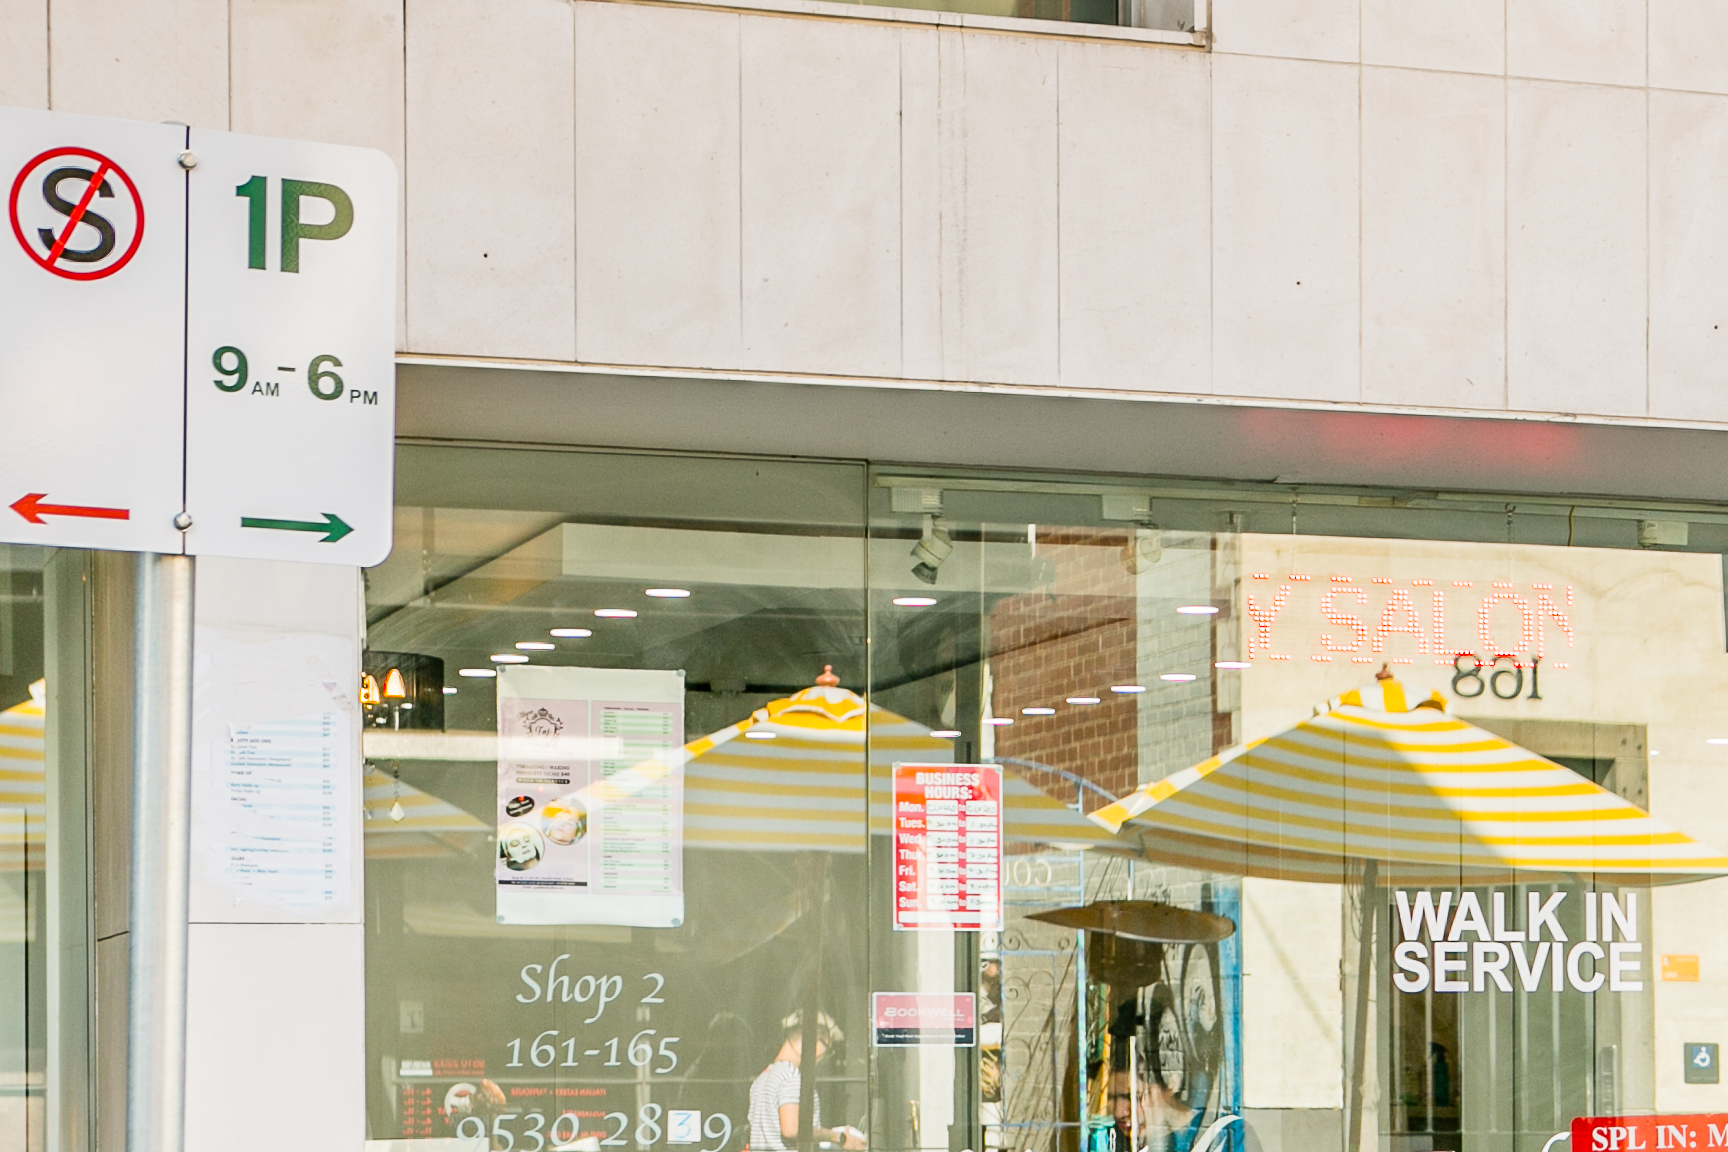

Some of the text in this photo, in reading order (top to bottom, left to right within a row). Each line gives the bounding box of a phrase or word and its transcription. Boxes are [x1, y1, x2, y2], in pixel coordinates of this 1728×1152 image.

[235, 174, 354, 274] 1P
[1320, 585, 1574, 660] SALON
[915, 771, 980, 787] BUSINESS
[924, 786, 973, 800] HOURS:
[898, 801, 925, 813] Mon.
[898, 817, 926, 828] Tues.
[898, 865, 916, 876] Fri.
[1395, 891, 1638, 942] WALK IN
[1392, 941, 1644, 993] SERVICE
[515, 953, 665, 1023] Shop 2
[505, 1029, 681, 1074] 161-165
[1591, 1125, 1646, 1152] SPL
[1655, 1123, 1698, 1150] IN:
